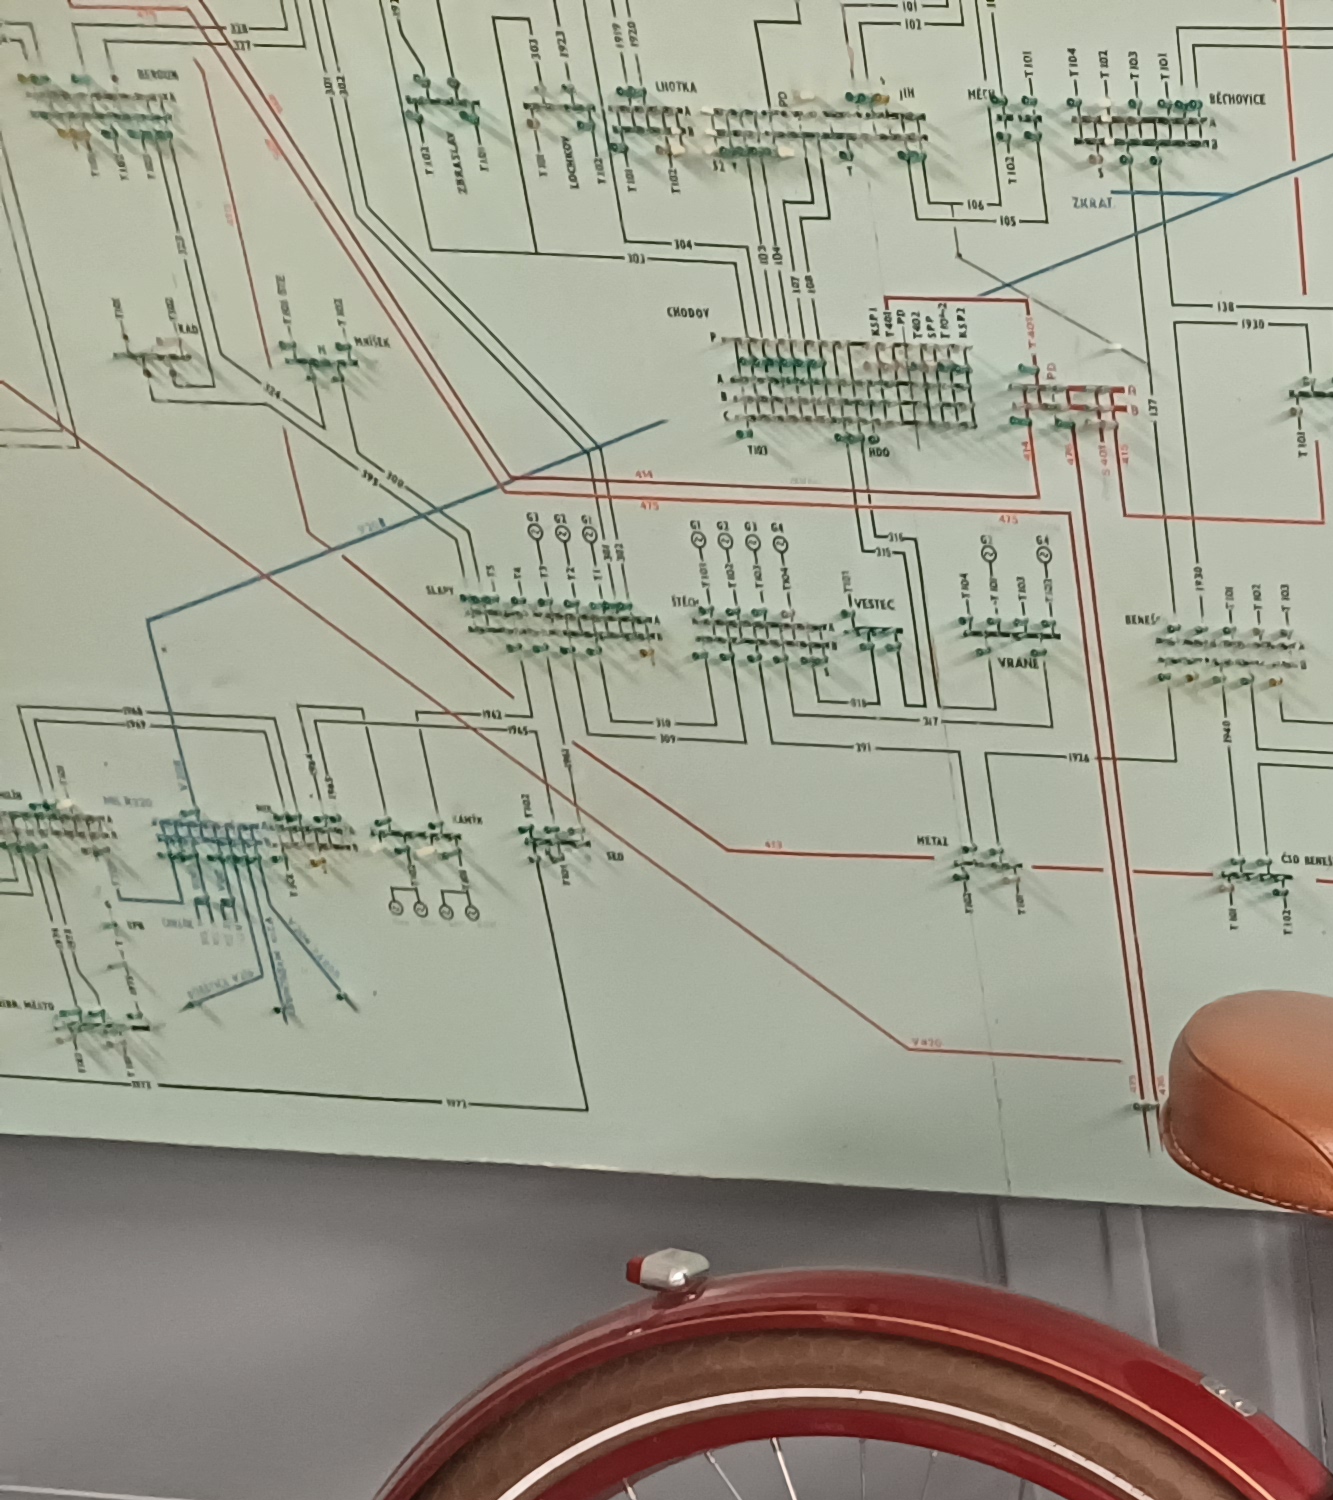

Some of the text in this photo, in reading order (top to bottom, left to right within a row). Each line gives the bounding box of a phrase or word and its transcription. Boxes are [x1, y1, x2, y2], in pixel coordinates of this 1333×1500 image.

[904, 18, 922, 30] 102
[656, 80, 698, 93] LHOTKA
[447, 132, 468, 194] ZBRASLAV
[561, 136, 579, 189] LOCHKOV
[666, 306, 710, 319] CHODOV
[1217, 301, 1234, 313] 138
[1241, 318, 1265, 330] 1930
[854, 598, 896, 611] VESTEC
